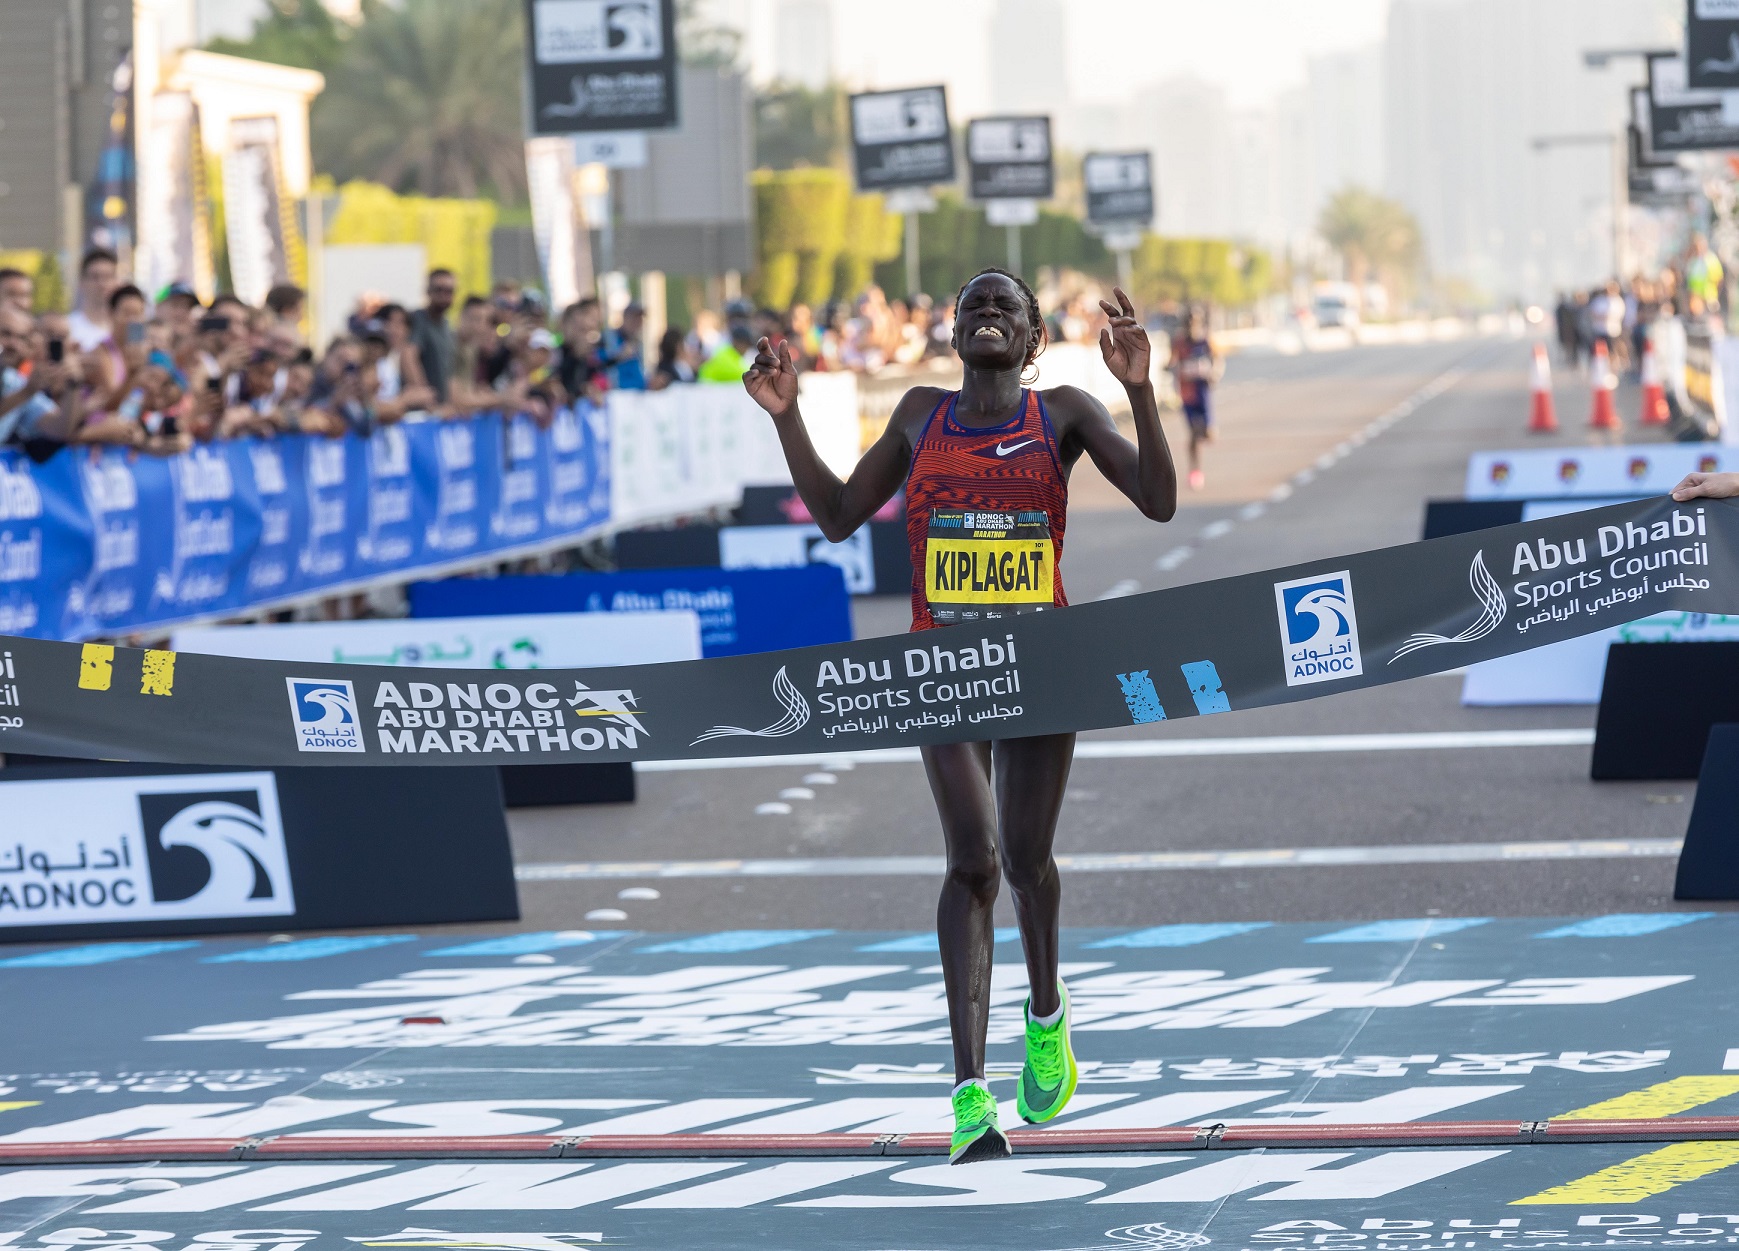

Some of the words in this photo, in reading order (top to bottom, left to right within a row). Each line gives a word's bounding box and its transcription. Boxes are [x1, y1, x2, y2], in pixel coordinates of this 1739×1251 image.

[973, 530, 1007, 538] MARATHON
[1512, 537, 1587, 575] Abu
[1598, 508, 1706, 558] Dhabi
[936, 550, 1043, 592] KIPLAGAT
[1513, 568, 1602, 608] Sports
[1610, 542, 1708, 580] Council
[1654, 572, 1710, 593] مجلس
[1586, 576, 1649, 616] أبوظبي
[1516, 598, 1580, 634] الرياضي
[816, 658, 892, 688] Abu
[904, 634, 1017, 678] Dhabi
[1291, 638, 1352, 661] أدنوك
[1294, 656, 1354, 678] ADNOC
[373, 682, 560, 709] ADNOC
[817, 688, 910, 717] Sports
[919, 670, 1021, 704] Council
[377, 710, 447, 728] ABU
[455, 710, 565, 728] DHABI
[822, 715, 888, 738] الرياضي
[896, 705, 962, 733] أبوظبي
[968, 704, 1024, 723] مجلس
[302, 726, 356, 738] أدنوك
[305, 738, 358, 748] ADNOC
[378, 726, 638, 753] MARATHON
[0, 879, 136, 909] ADNOC
[0, 1084, 1524, 1142] FINISH
[0, 1150, 1511, 1214] FINISH
[0, 1229, 322, 1245] OC
[1250, 1230, 1569, 1244] Sports
[1606, 1226, 1739, 1236] Co
[1258, 1218, 1522, 1231] Abu
